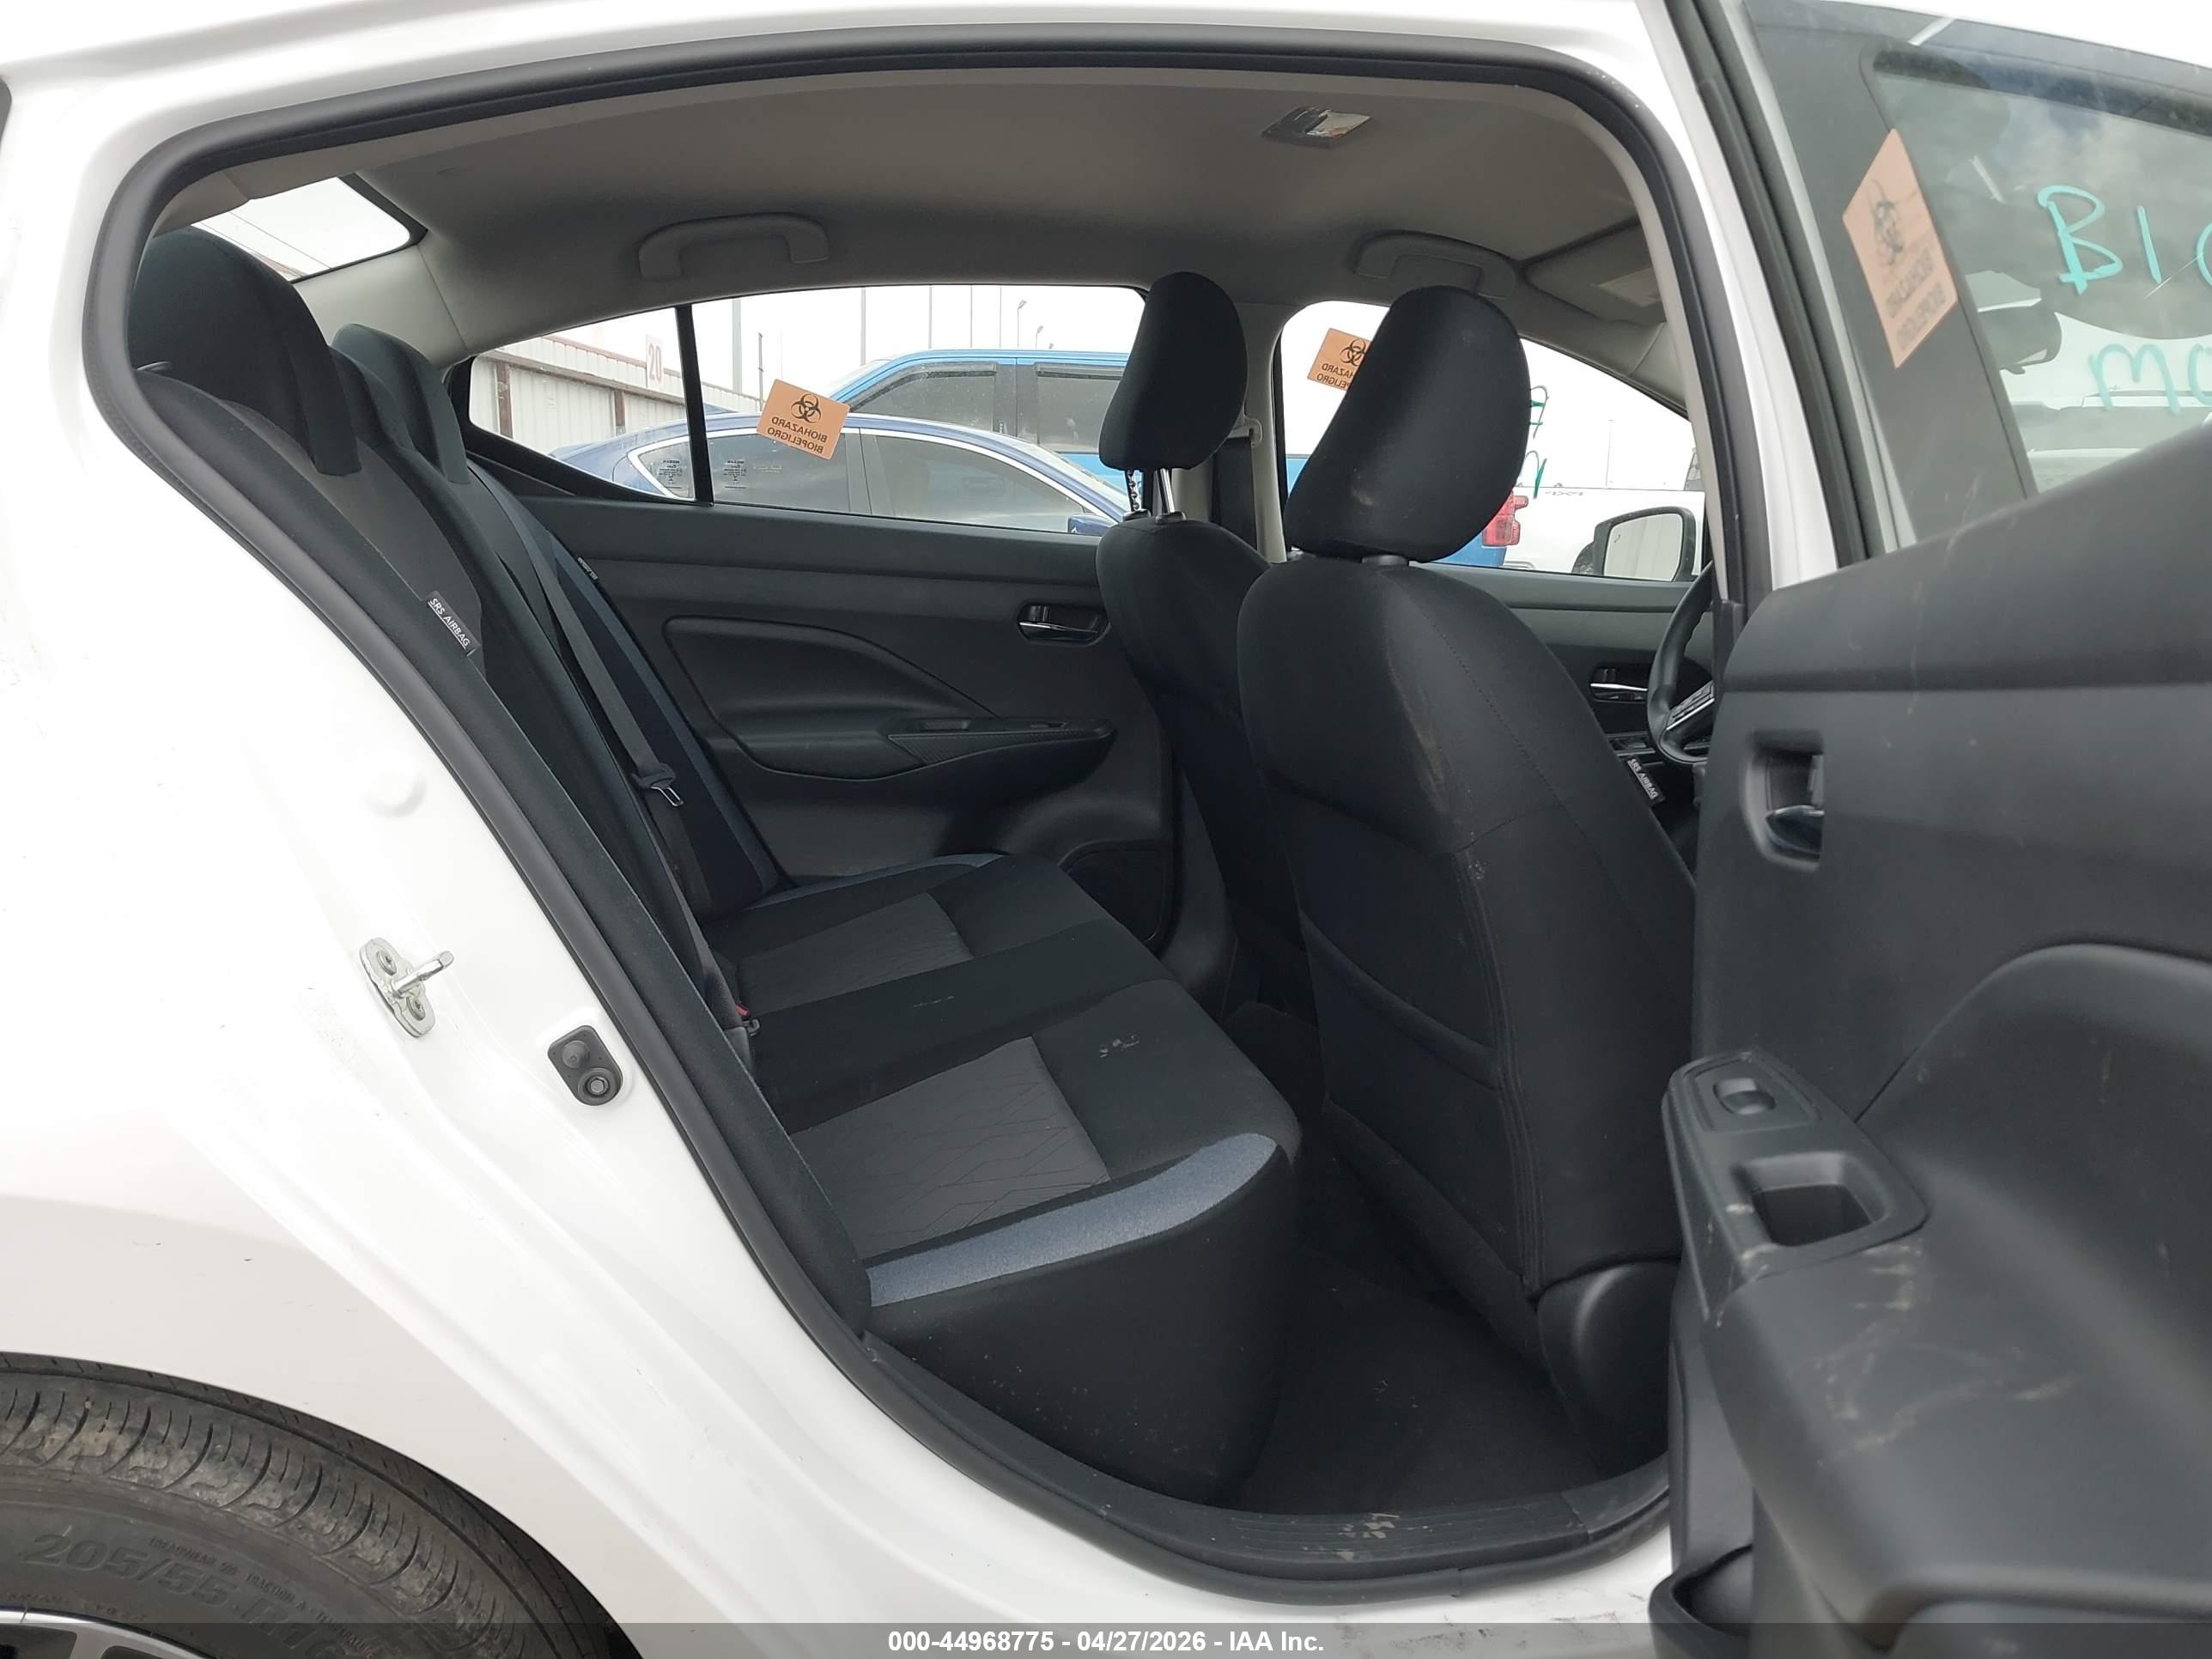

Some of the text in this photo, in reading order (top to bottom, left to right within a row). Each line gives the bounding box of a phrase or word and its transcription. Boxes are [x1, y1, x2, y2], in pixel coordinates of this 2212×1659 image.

[2038, 185, 2212, 295] BI
[647, 343, 662, 384] 20
[429, 598, 471, 647] SRS AIRBAG
[1637, 773, 1659, 799] AIRBAG
